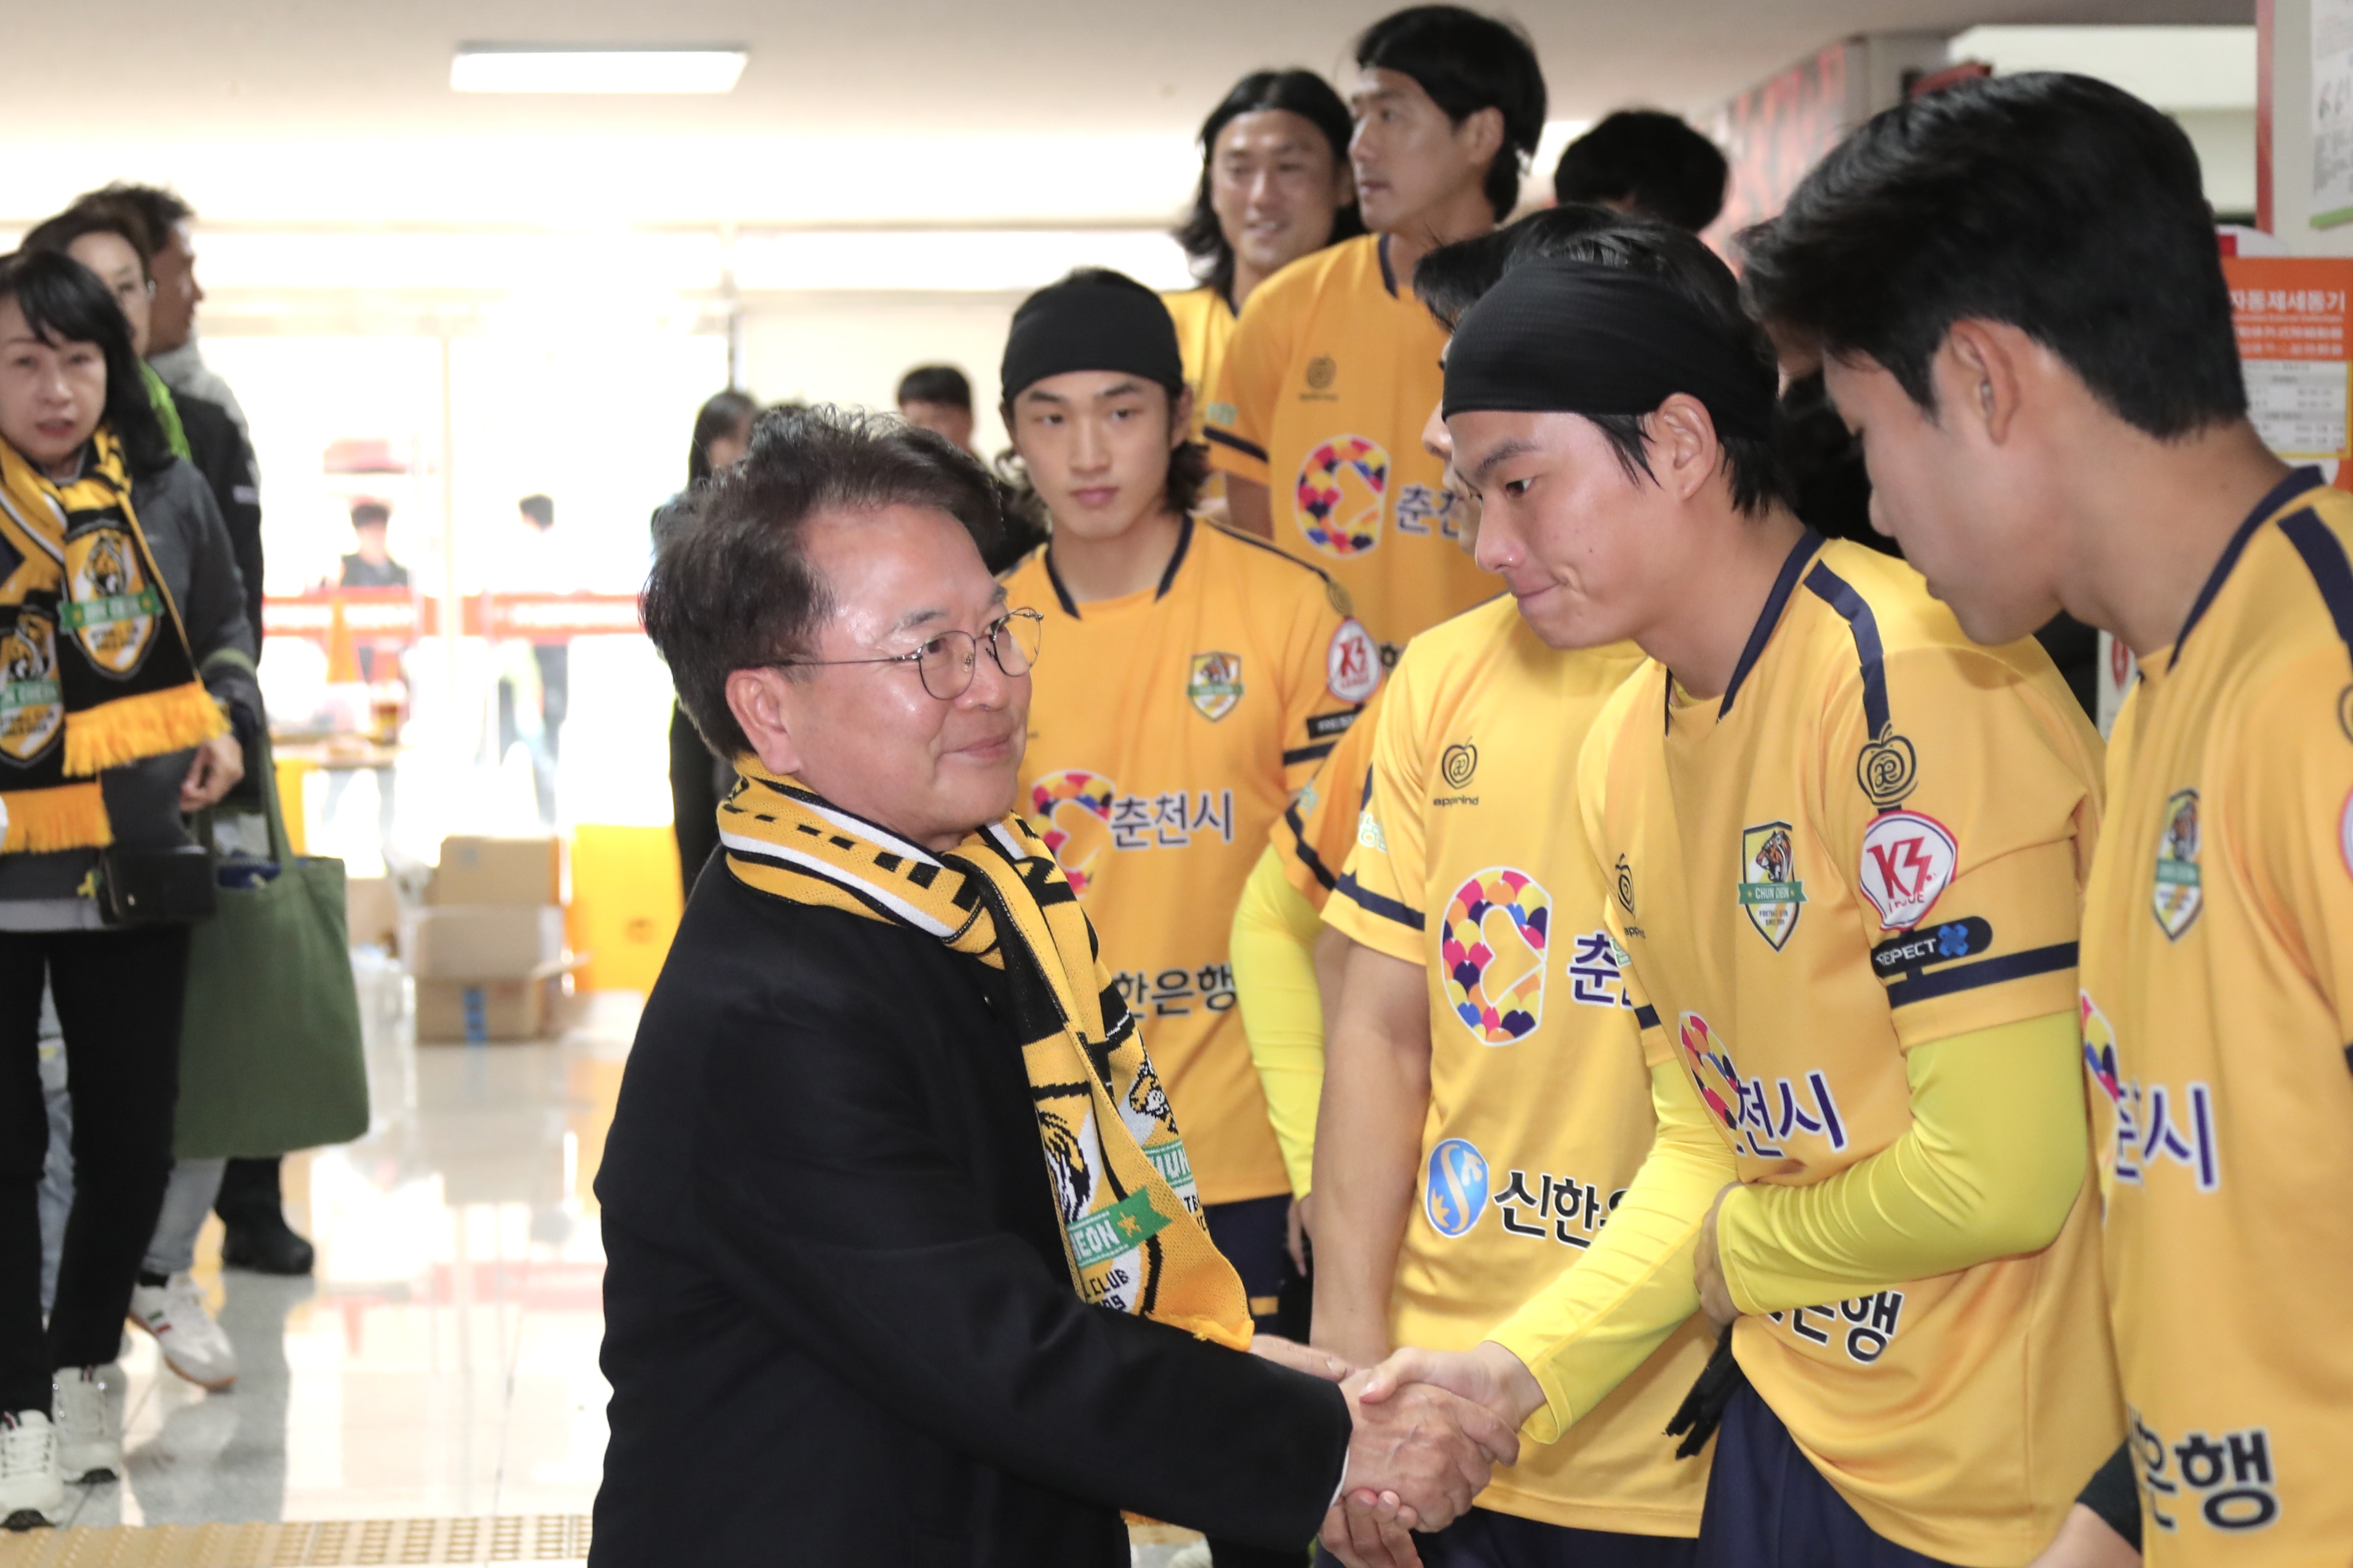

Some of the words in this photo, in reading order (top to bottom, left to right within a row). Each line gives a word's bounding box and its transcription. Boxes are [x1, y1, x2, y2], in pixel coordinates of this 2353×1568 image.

[1109, 790, 1232, 848] 춘천시
[1866, 836, 1933, 900] K3
[1090, 1268, 1130, 1295] CLUB
